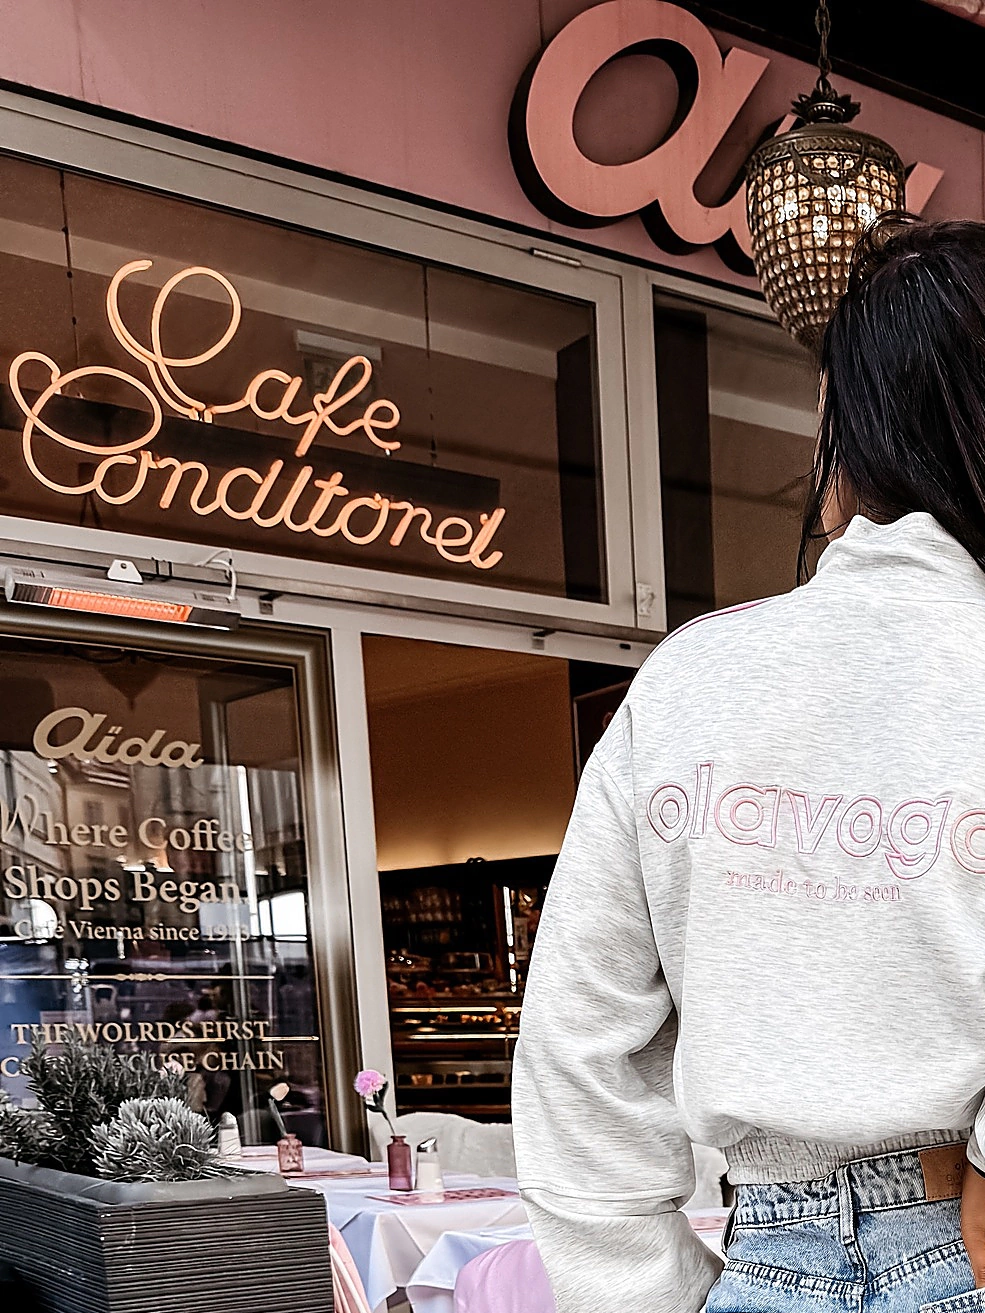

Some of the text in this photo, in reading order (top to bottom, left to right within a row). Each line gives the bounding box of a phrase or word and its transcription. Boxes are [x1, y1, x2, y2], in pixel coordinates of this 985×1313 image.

[107, 259, 401, 457] Cafe
[1, 795, 253, 852] Where Coffee
[4, 865, 121, 911] Shops
[725, 868, 902, 903] made to be seen
[68, 919, 144, 941] Vienna
[150, 922, 199, 942] since
[201, 1020, 269, 1042] FIRST
[202, 1050, 285, 1072] CHAIN
